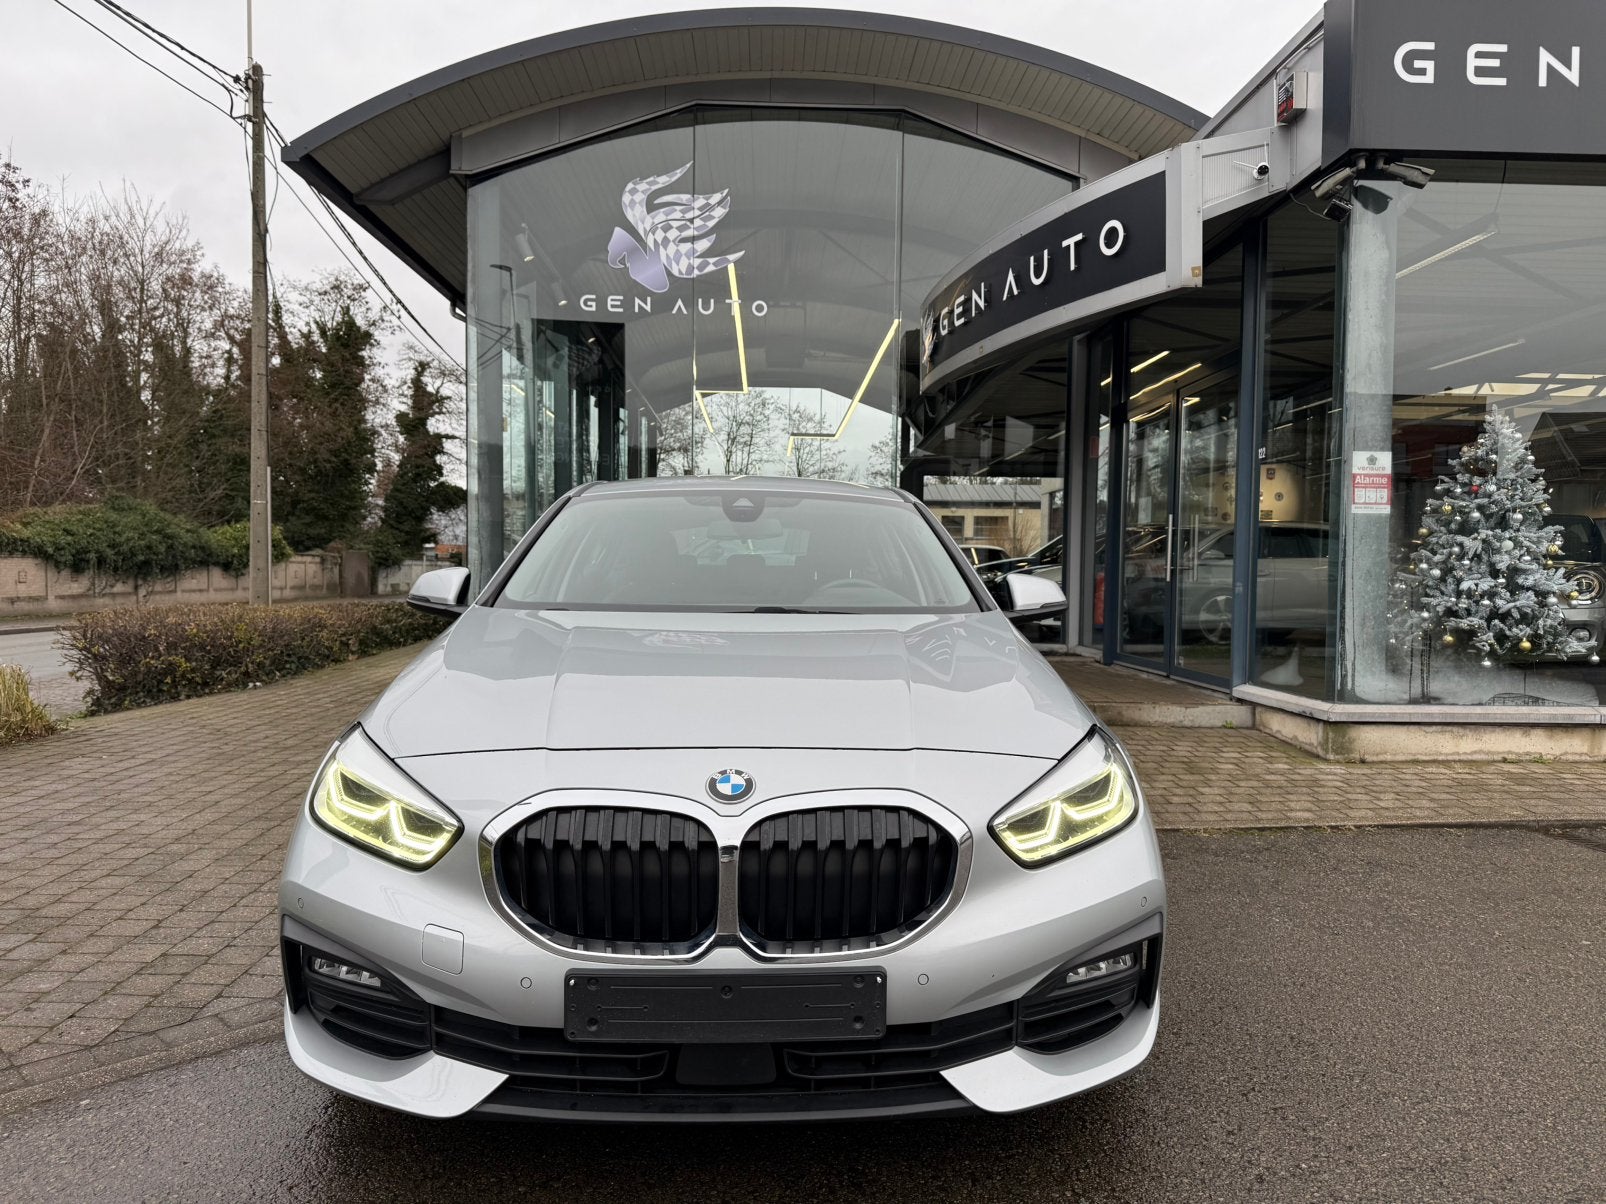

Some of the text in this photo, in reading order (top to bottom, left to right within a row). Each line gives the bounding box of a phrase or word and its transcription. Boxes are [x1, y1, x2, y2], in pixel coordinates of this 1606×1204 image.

[1393, 41, 1581, 88] GEN
[939, 219, 1125, 336] GEN AUTO
[580, 294, 768, 317] GEN AUTO
[1355, 475, 1388, 484] Alarme
[712, 769, 751, 780] BMW
